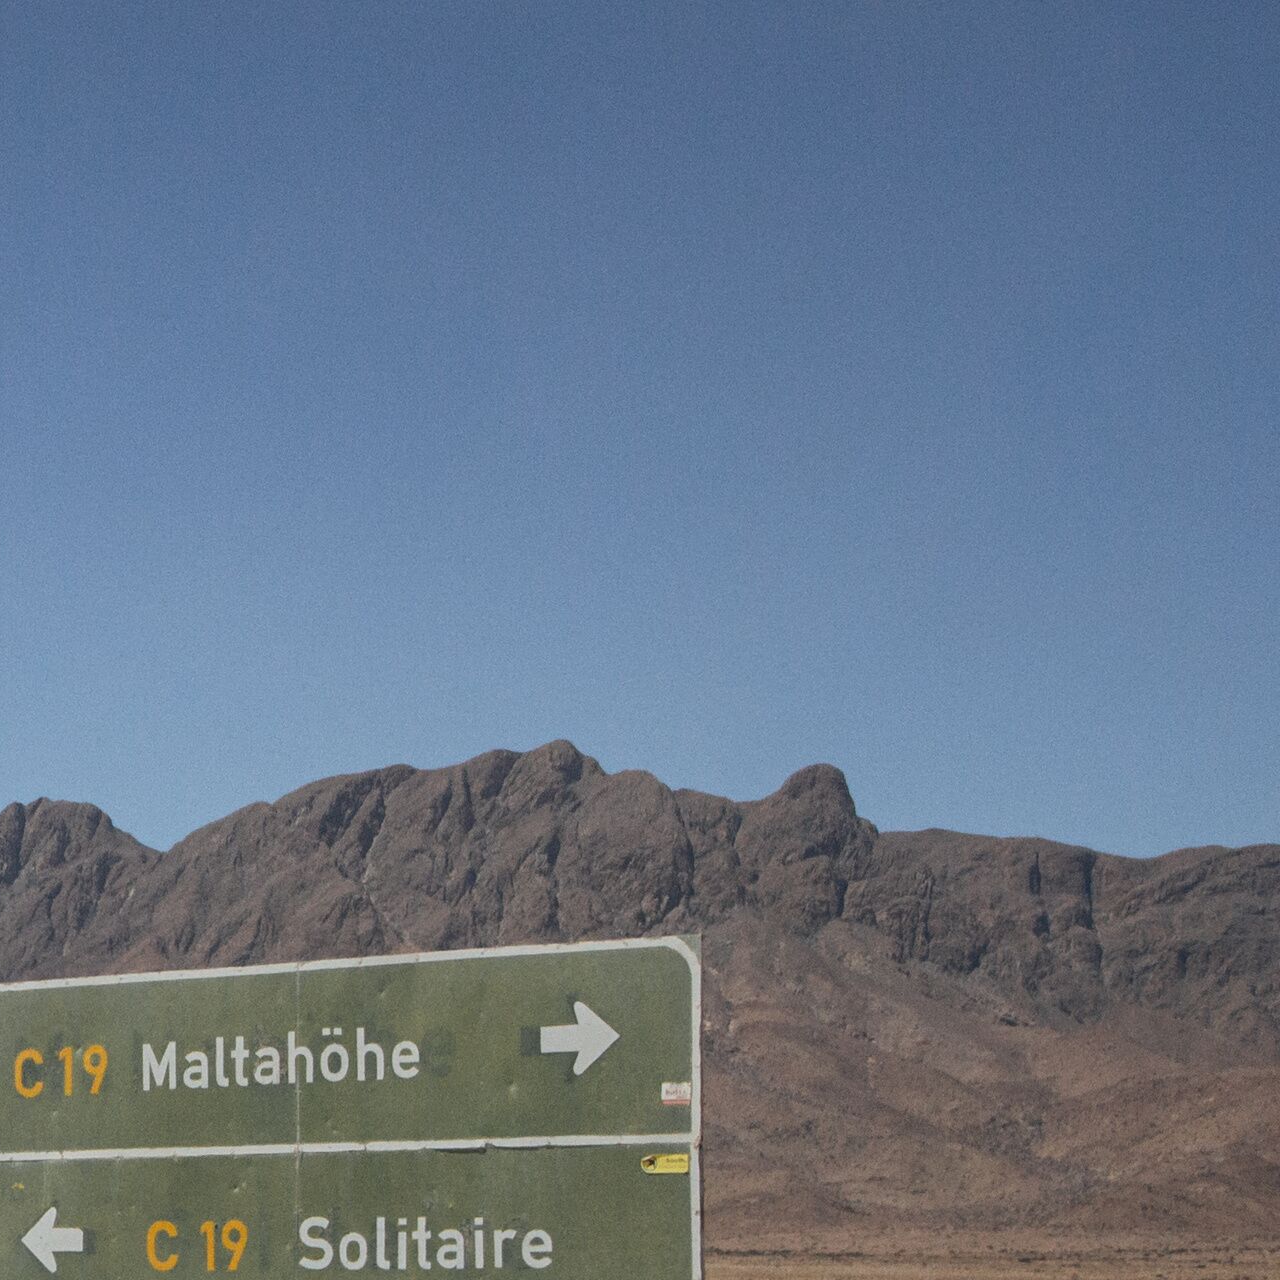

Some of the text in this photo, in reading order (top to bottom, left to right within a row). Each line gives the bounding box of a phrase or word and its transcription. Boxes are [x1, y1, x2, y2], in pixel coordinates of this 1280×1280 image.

[14, 1027, 420, 1098] C 19 Maltahöhe
[146, 1216, 553, 1272] C 19 Solitaire
